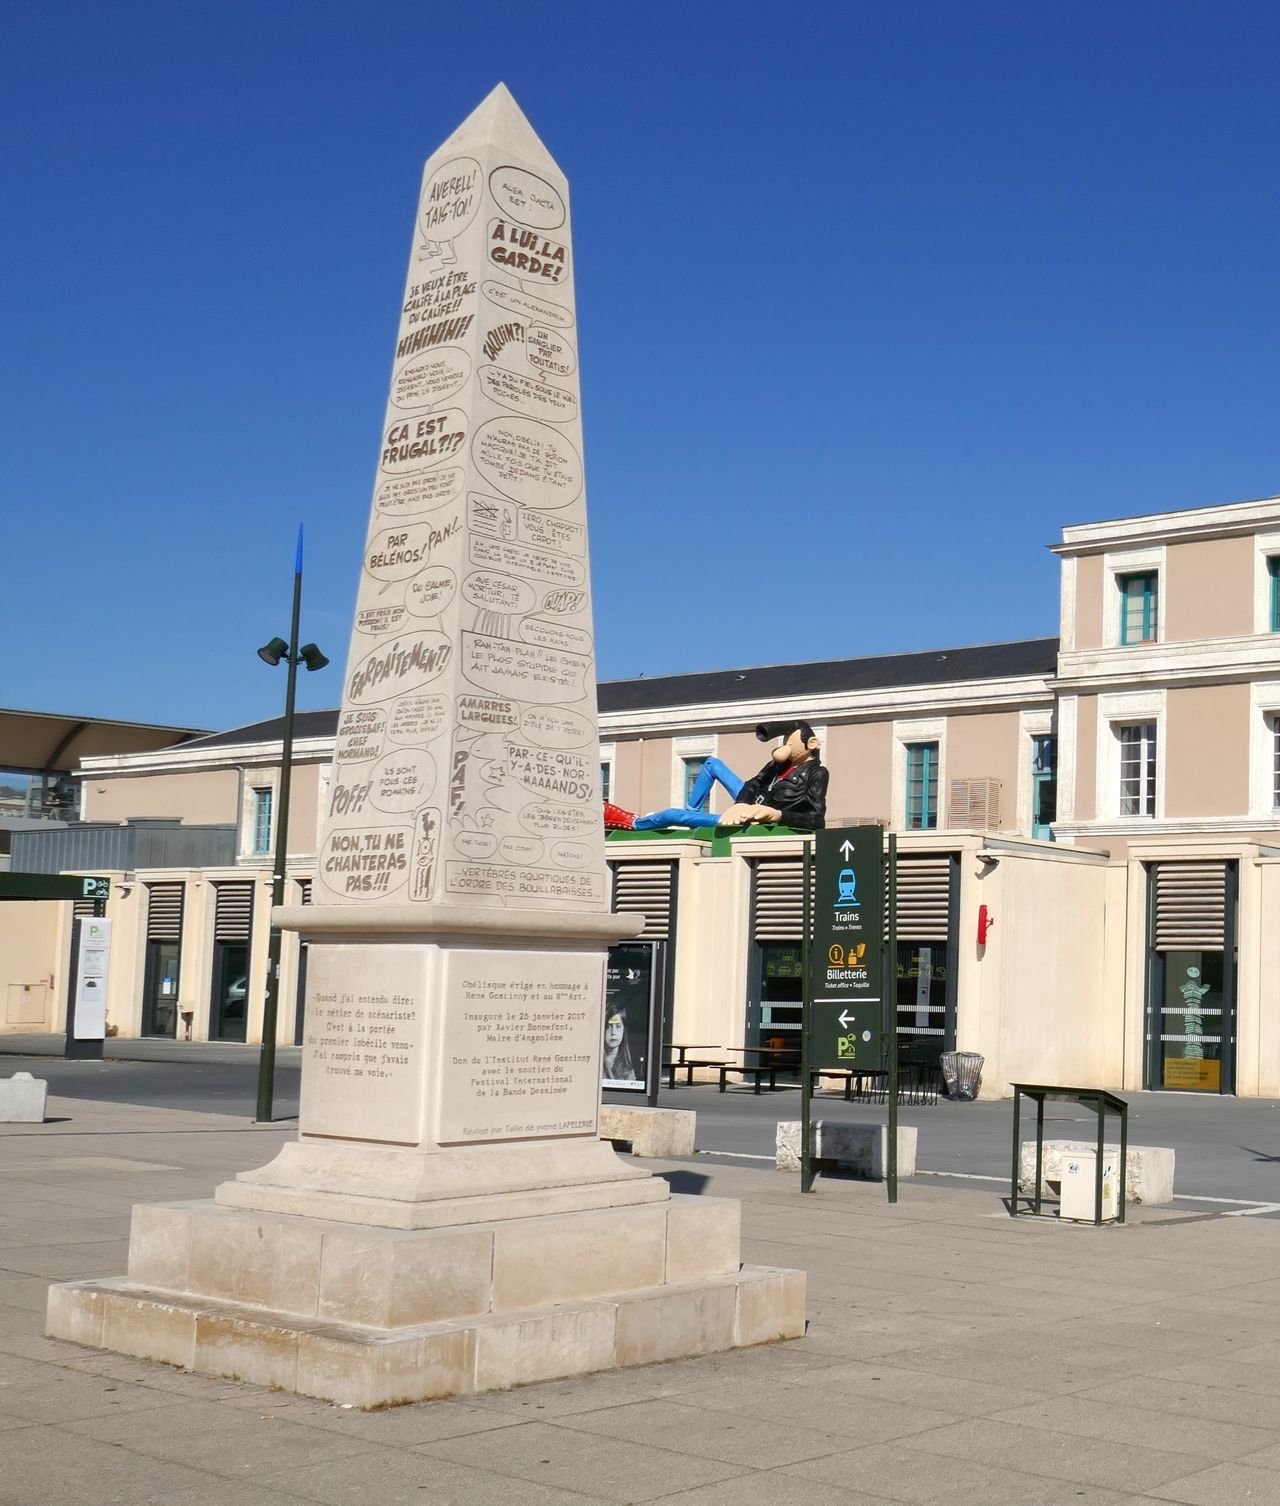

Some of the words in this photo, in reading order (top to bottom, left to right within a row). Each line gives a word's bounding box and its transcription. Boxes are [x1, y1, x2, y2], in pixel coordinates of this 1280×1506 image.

[429, 169, 476, 202] AVERELL!
[502, 183, 523, 196] ALEA
[426, 194, 473, 229] TAIS-TOI!
[492, 219, 505, 240] À
[491, 247, 563, 282] GARDE!
[422, 276, 446, 294] VEUX
[446, 271, 468, 287] ÊTRE
[441, 289, 451, 302] LA
[452, 281, 477, 300] PLACE
[409, 311, 420, 325] DU
[537, 331, 548, 340] UN
[538, 348, 552, 358] PAR
[502, 381, 531, 398] PAROLES
[535, 384, 553, 396] SOUS
[388, 424, 409, 446] ÇA
[416, 416, 448, 438] EST
[382, 431, 465, 466] FRUGAL?!?
[548, 444, 557, 453] TU
[525, 462, 541, 472] QUE
[509, 465, 540, 482] DEDANS
[524, 523, 544, 534] VOUS
[552, 528, 571, 541] ÊTES
[387, 533, 408, 549] PAR
[475, 576, 489, 586] AVE
[471, 651, 484, 660] LE
[488, 653, 514, 665] PLUS
[517, 660, 559, 674] STUPIDE
[546, 655, 557, 663] LE
[460, 698, 512, 713] AMARRES
[343, 713, 354, 724] JE
[347, 736, 368, 747] CHEF
[338, 745, 380, 760] NORMAND!
[397, 765, 417, 775] SONT
[381, 778, 399, 786] FOUS
[403, 776, 418, 784] CES
[451, 750, 470, 817] PAF!
[329, 781, 374, 818] POFF!
[365, 834, 381, 849] TU
[384, 832, 405, 850] NE
[326, 853, 407, 872] CHANTERAS
[83, 878, 97, 895] P
[345, 872, 391, 892] PAS!!!
[450, 877, 492, 890] L'ORDRE
[496, 879, 515, 892] DES
[581, 877, 592, 886] DE
[834, 911, 859, 922] Trains
[827, 968, 867, 980] Billetterie
[550, 980, 581, 991] hommage
[358, 995, 389, 1004] entendu
[489, 991, 527, 1001] Goscinny
[356, 1009, 364, 1018] de
[507, 1012, 515, 1020] le
[532, 1013, 564, 1022] janvier
[357, 1024, 366, 1033] la
[369, 1024, 396, 1034] portée
[477, 1024, 492, 1032] par
[496, 1023, 525, 1031] Xavier
[528, 1023, 573, 1032] Bonnefont,
[320, 1037, 350, 1046] premier
[486, 1034, 511, 1042] Maire
[838, 1037, 849, 1056] P
[331, 1051, 361, 1062] compris
[364, 1054, 377, 1064] que
[453, 1057, 468, 1065] Don
[471, 1056, 481, 1065] de
[485, 1056, 529, 1064] l'Institut
[554, 1054, 591, 1064] Goscinny
[505, 1067, 515, 1075] le
[518, 1067, 551, 1075] soutien
[554, 1065, 564, 1073] du
[471, 1078, 510, 1086] Festival
[514, 1076, 573, 1085] International
[476, 1089, 486, 1097] de
[503, 1087, 526, 1096] Bande
[530, 1087, 567, 1095] Dessinée
